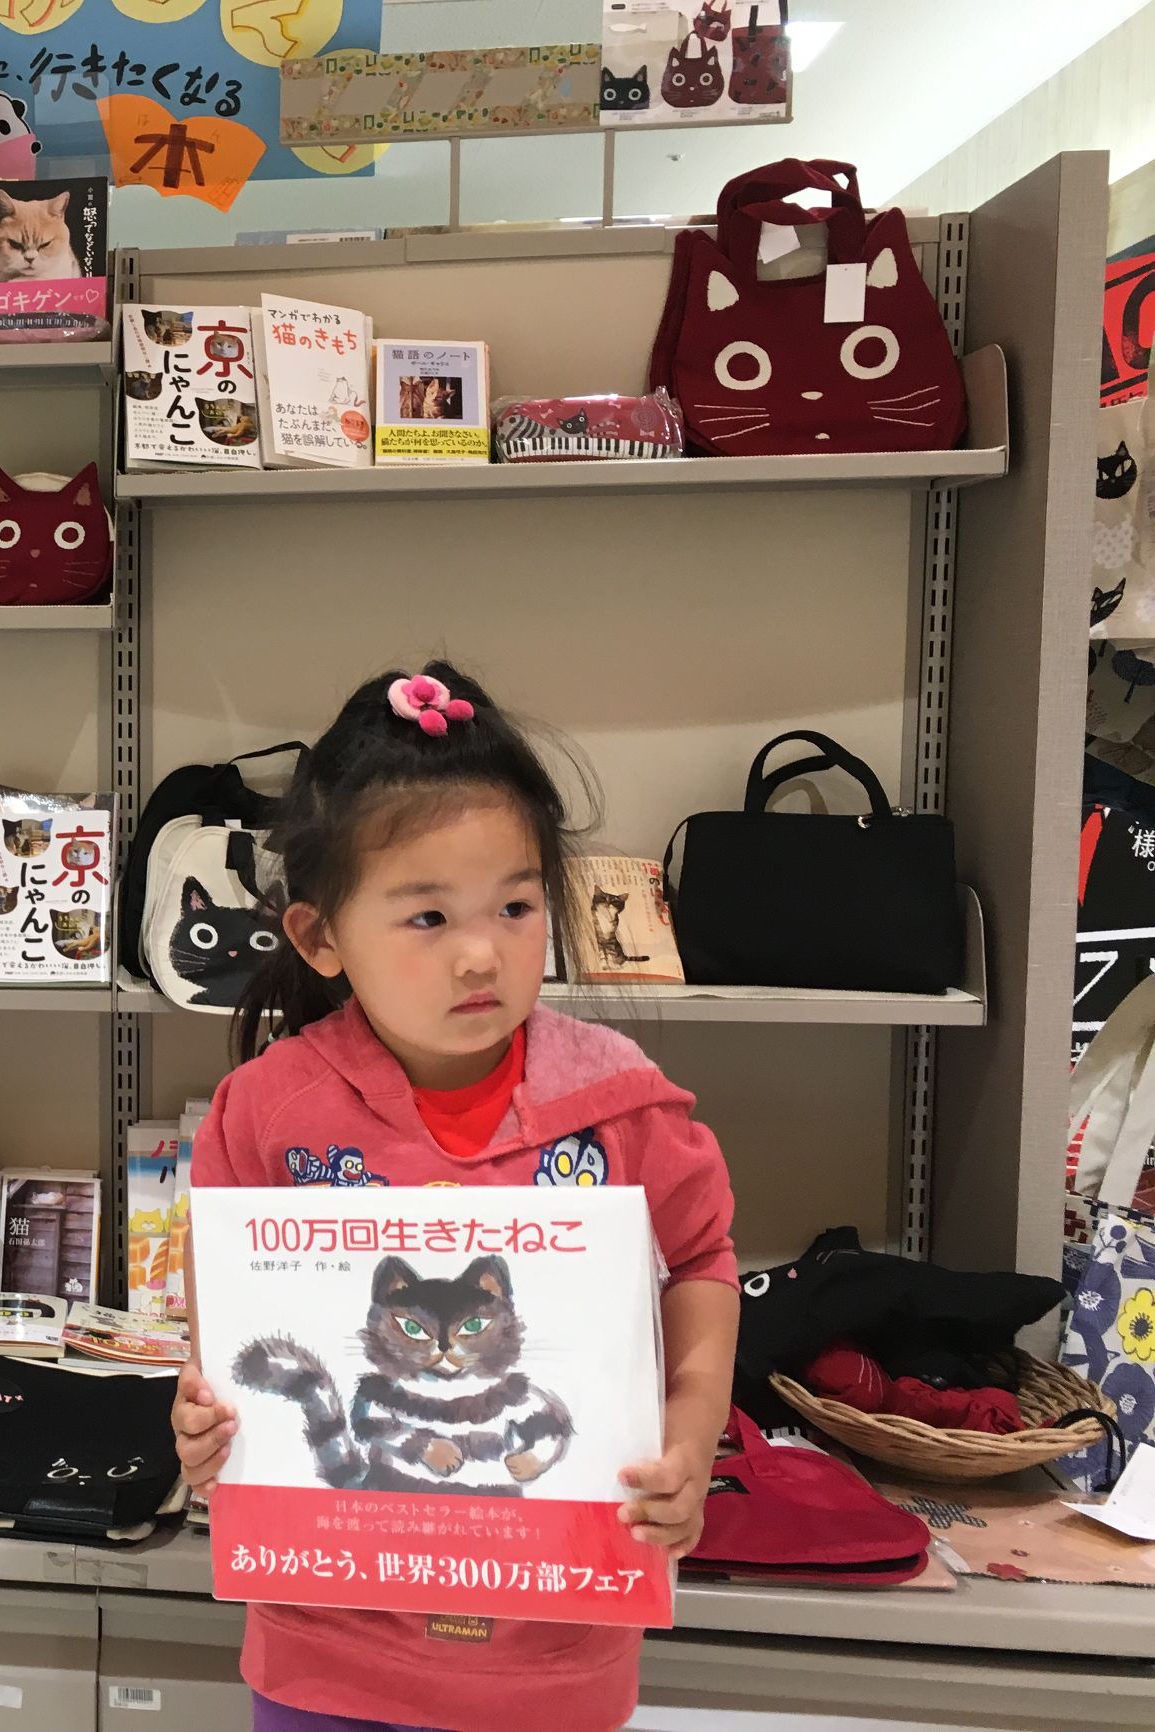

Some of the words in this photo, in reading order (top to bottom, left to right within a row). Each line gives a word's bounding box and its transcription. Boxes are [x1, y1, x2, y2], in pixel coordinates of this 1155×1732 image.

[129, 123, 216, 190] 本
[267, 309, 341, 325] マンガでわかる
[272, 322, 357, 355] 猫のきもち
[392, 349, 470, 361] 猫語のノート
[163, 350, 196, 445] にゃんこ
[275, 403, 319, 415] あなたは
[278, 418, 337, 432] たぶんまだ、
[281, 432, 367, 450] 猫を誤解している。
[20, 862, 49, 962] にゃんこ
[9, 1216, 31, 1237] 猫
[245, 1218, 587, 1253] 100万回生きたねこ
[250, 1260, 303, 1272] 佐野洋子
[314, 1260, 351, 1272] 作・絵
[334, 1499, 524, 1522] 日本のベストセラー絵本が、
[231, 1544, 645, 1595] ありがとう、世界300万部フェア
[431, 1622, 487, 1638] ULTRAMAN
